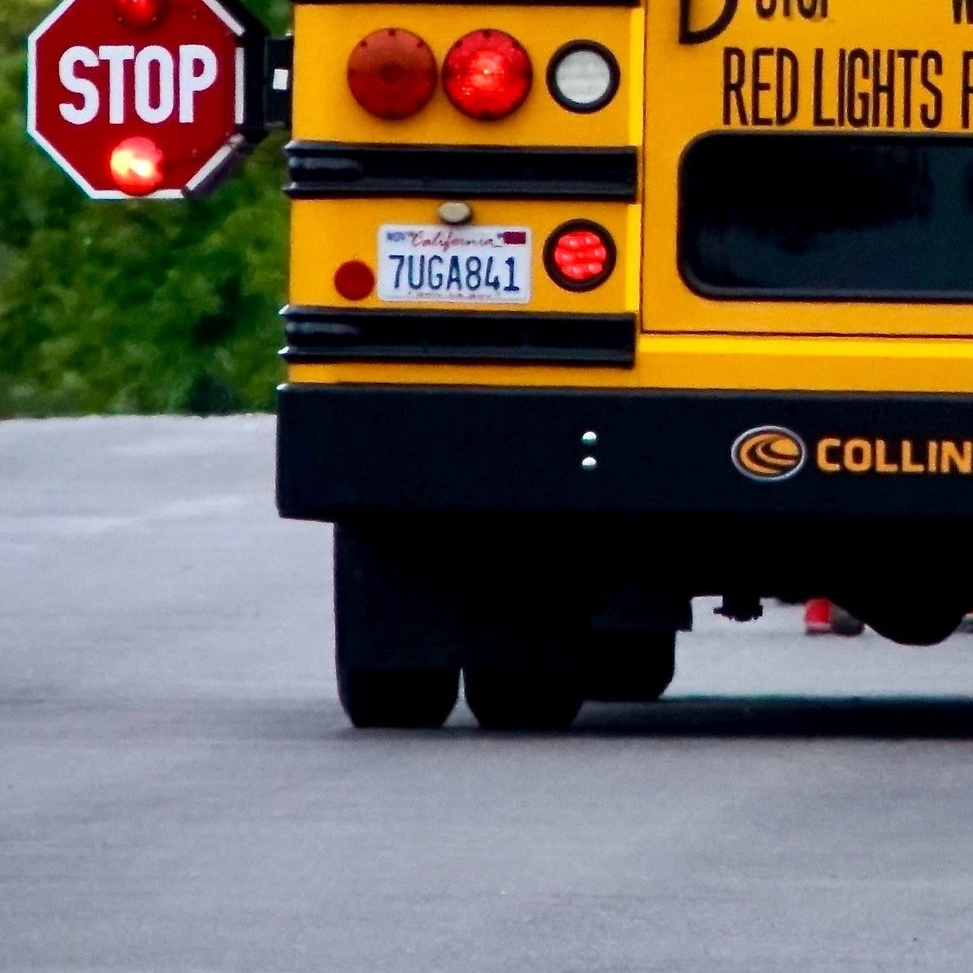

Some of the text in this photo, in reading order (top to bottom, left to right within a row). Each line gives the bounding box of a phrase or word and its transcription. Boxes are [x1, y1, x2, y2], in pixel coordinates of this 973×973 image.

[58, 44, 218, 125] STOP
[722, 47, 799, 127] RED
[812, 47, 943, 129] LIGHTS
[388, 254, 520, 292] 7UGA841
